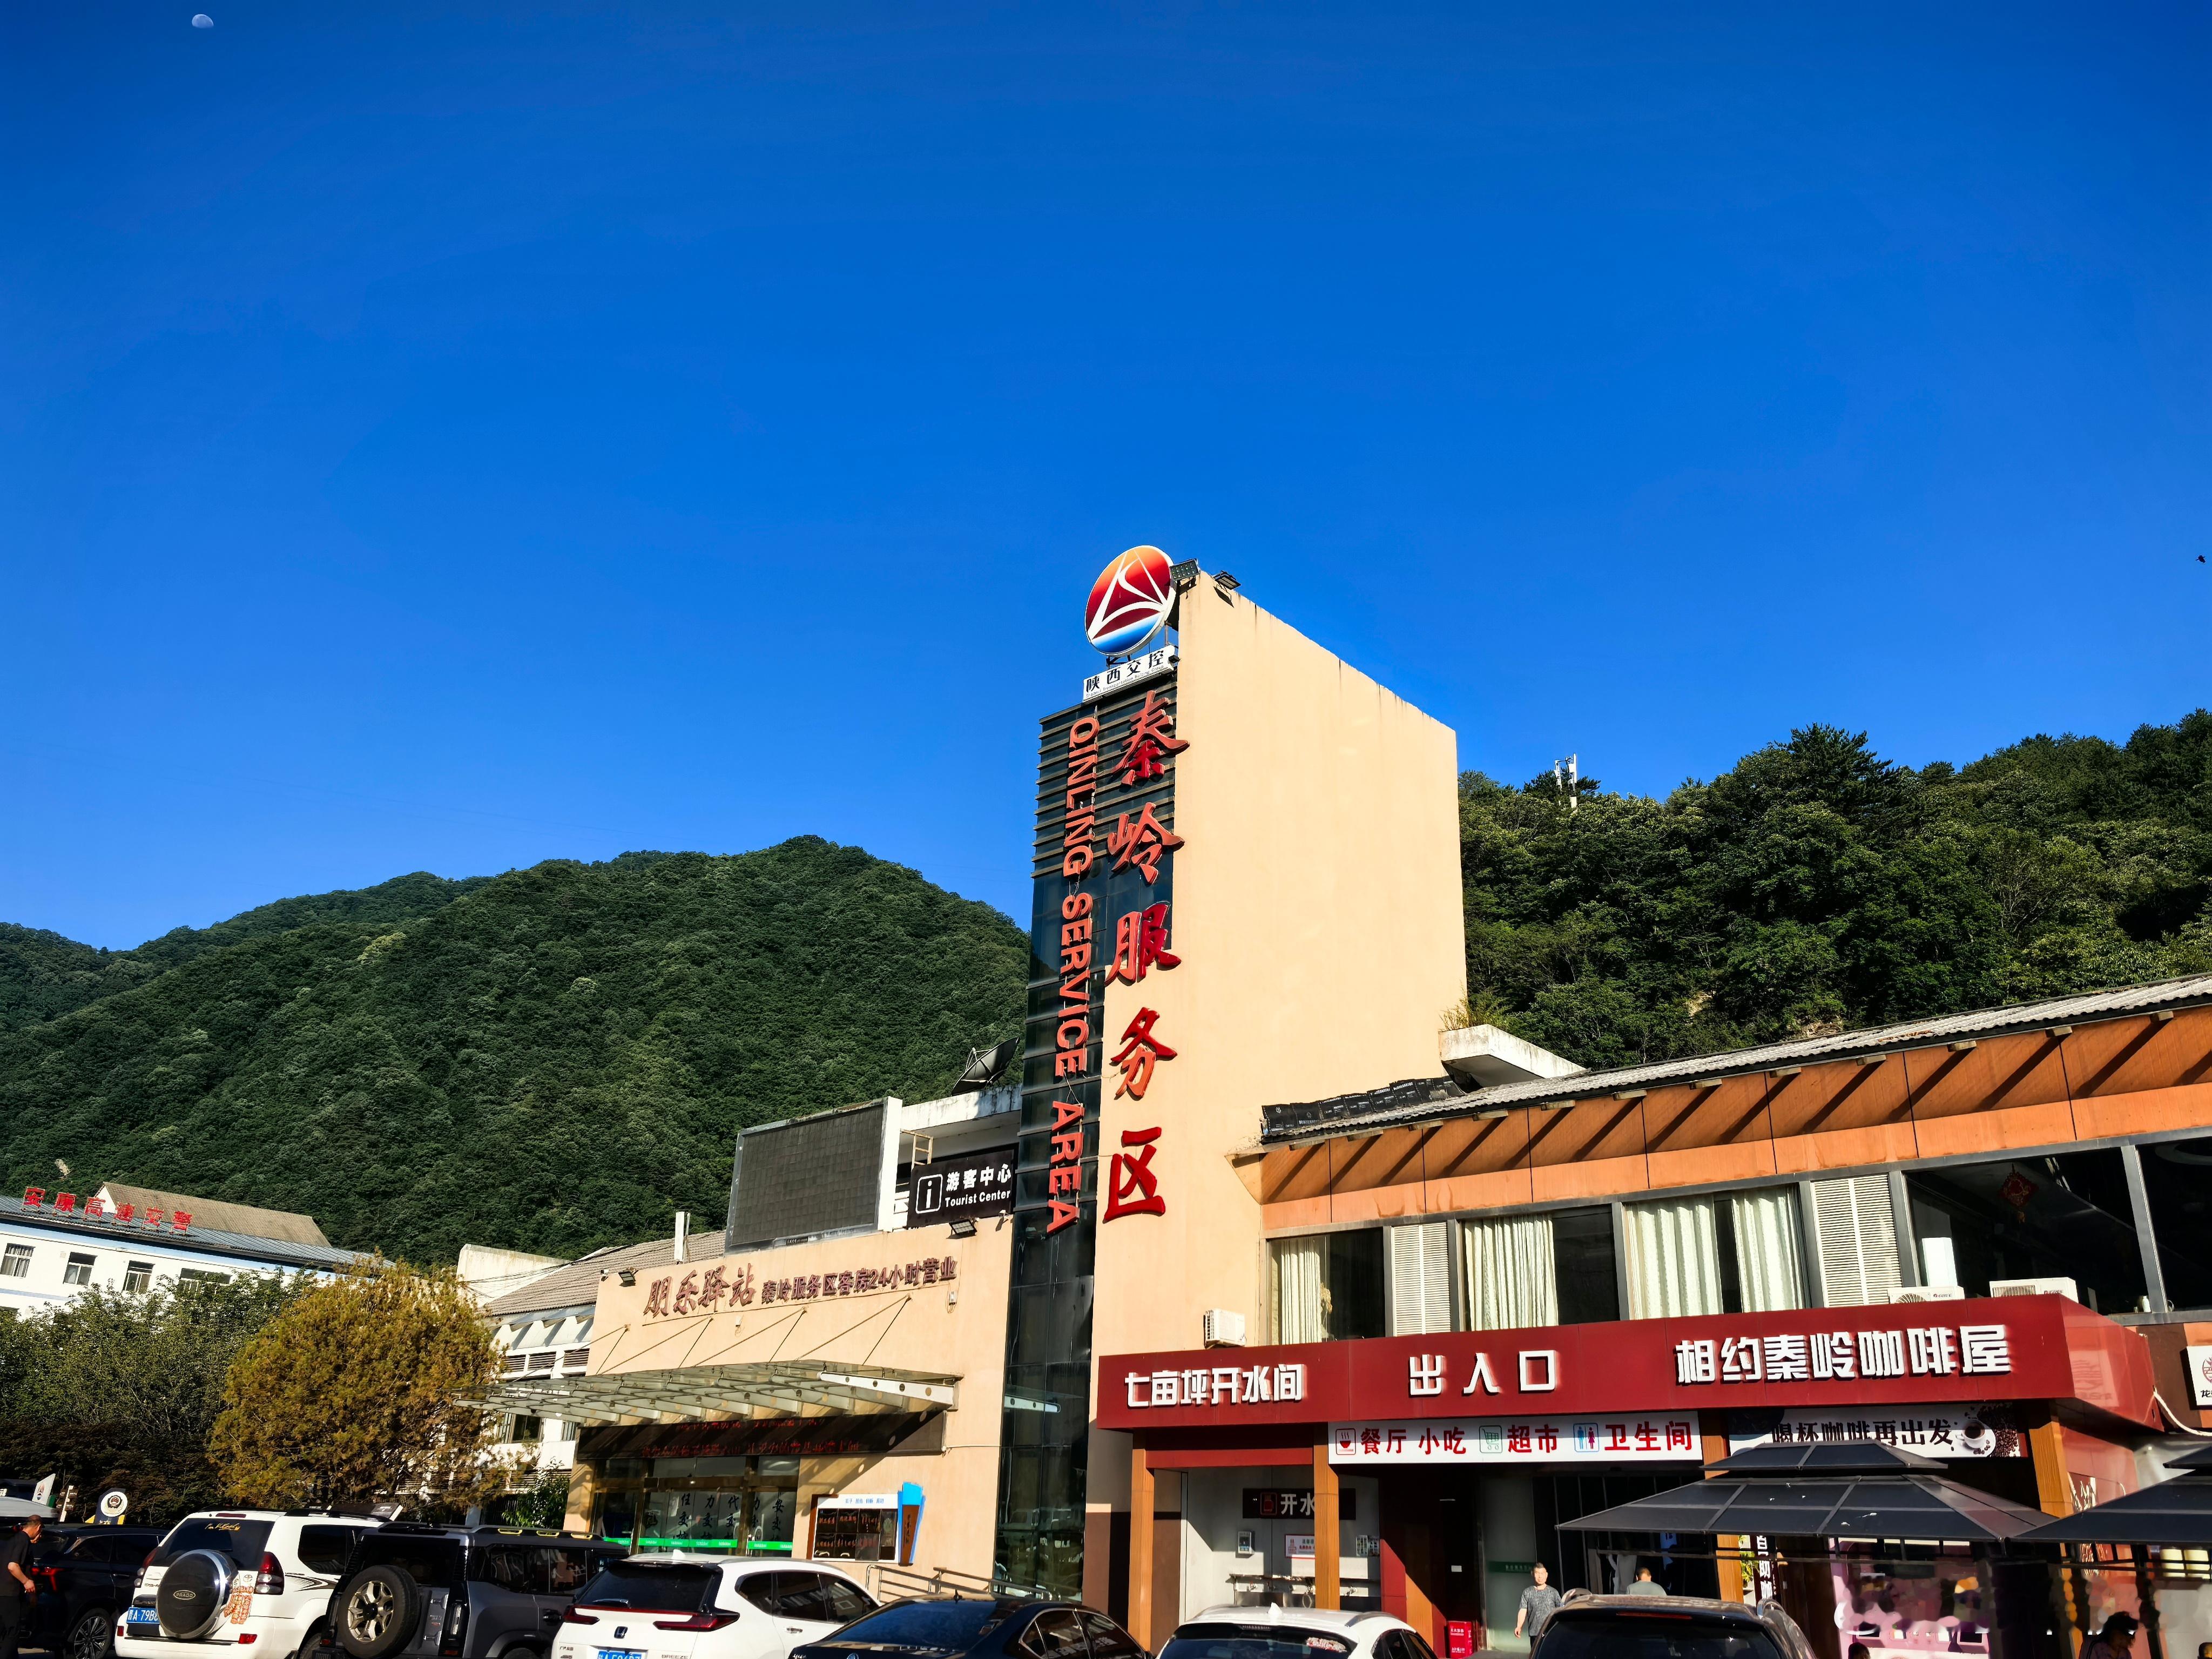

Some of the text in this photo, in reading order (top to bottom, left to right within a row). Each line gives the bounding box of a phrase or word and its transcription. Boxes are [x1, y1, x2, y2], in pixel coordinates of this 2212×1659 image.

[1086, 650, 1164, 692] 陕西交控
[1046, 717, 1100, 1235] QINLING SERVICE AREA
[1103, 690, 1190, 1223] 秦岭服务区
[946, 1163, 1011, 1191] 游客中心
[945, 1190, 1011, 1208] Tourist Center
[761, 1256, 957, 1304] 秦岭服务区客房24小时营业
[1408, 1350, 1557, 1396] 出入口
[1675, 1324, 2012, 1385] 相约秦岭咖啡屋
[1124, 1364, 1306, 1408] 七亩坪开水间
[2200, 1390, 2212, 1398] 花
[1360, 1420, 1693, 1454] 餐厅 小吃 超市 卫生间
[1772, 1419, 1953, 1446] 喝杯咖啡再出发
